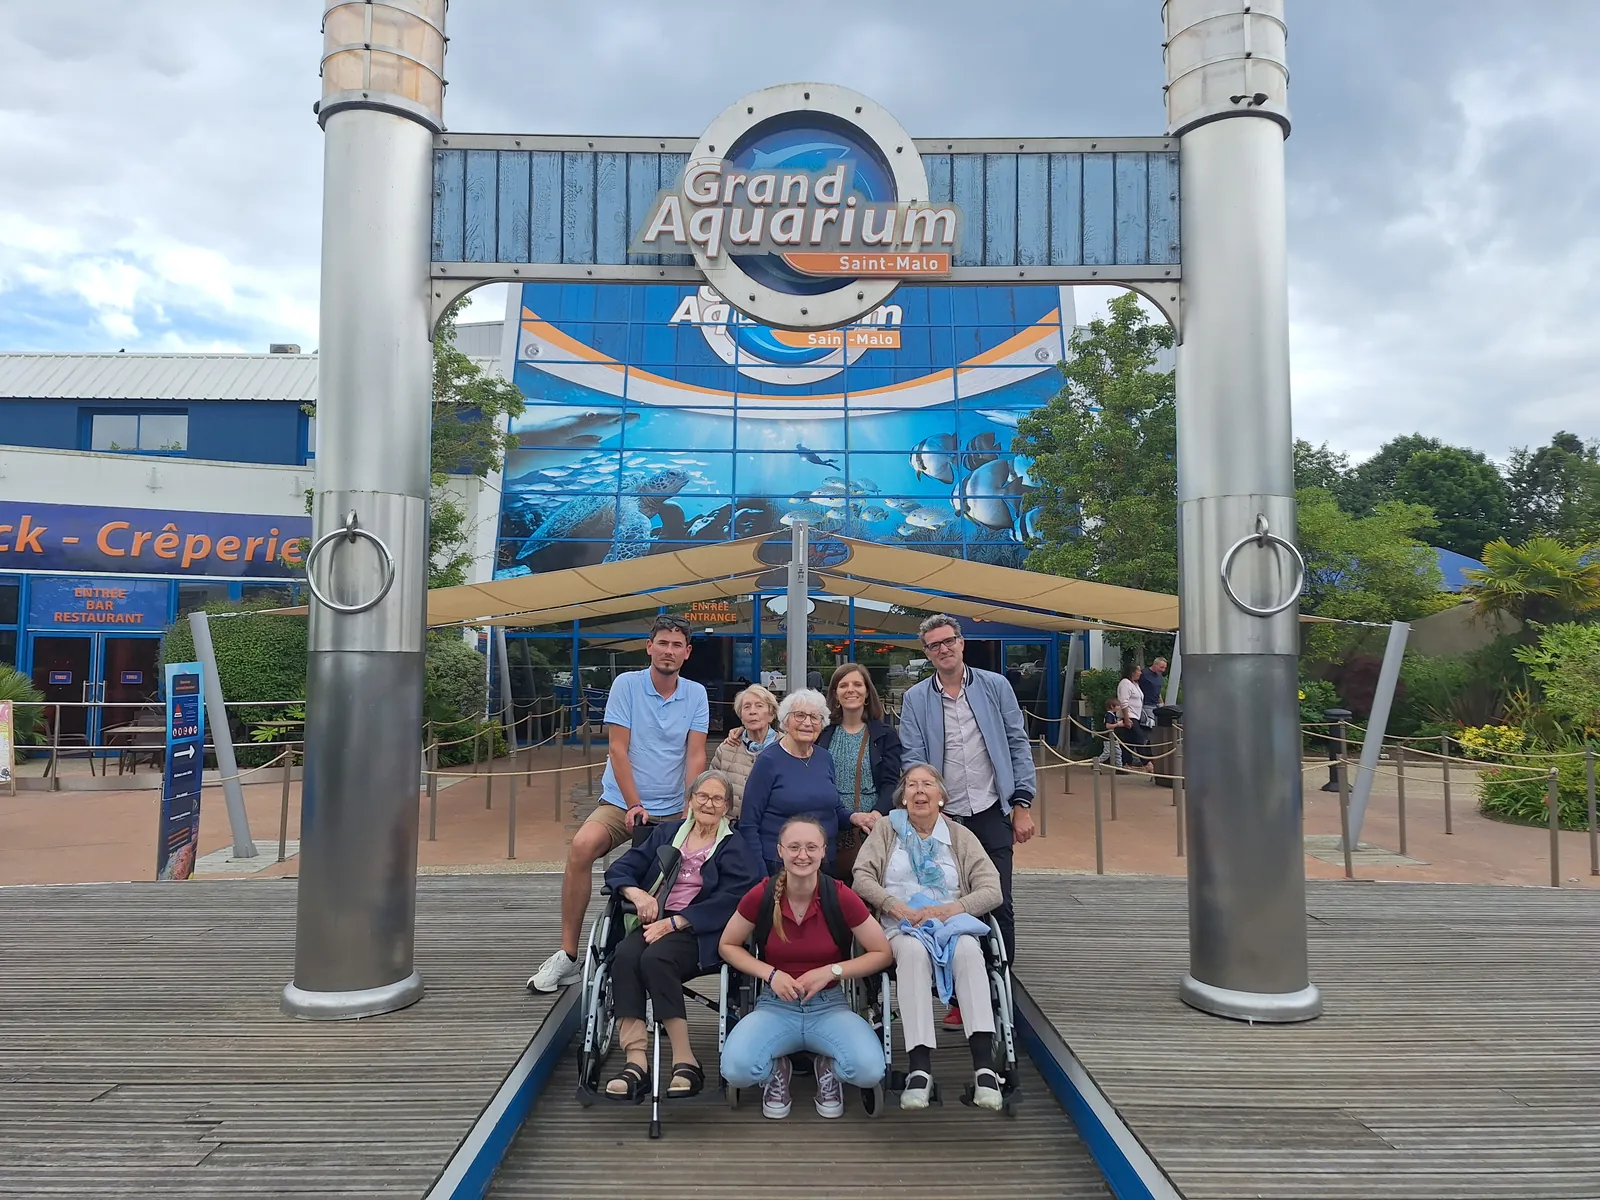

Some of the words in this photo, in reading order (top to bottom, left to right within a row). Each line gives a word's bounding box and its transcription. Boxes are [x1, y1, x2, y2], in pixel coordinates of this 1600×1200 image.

[684, 163, 846, 206] Grand
[643, 195, 957, 259] Aquarium
[839, 256, 938, 270] Saint-Malo
[808, 333, 893, 345] Sain-Malo
[97, 521, 303, 568] Crêperie
[86, 600, 114, 611] BAR
[54, 611, 144, 624] RESTAURANT
[684, 612, 737, 622] ENTRANCE
